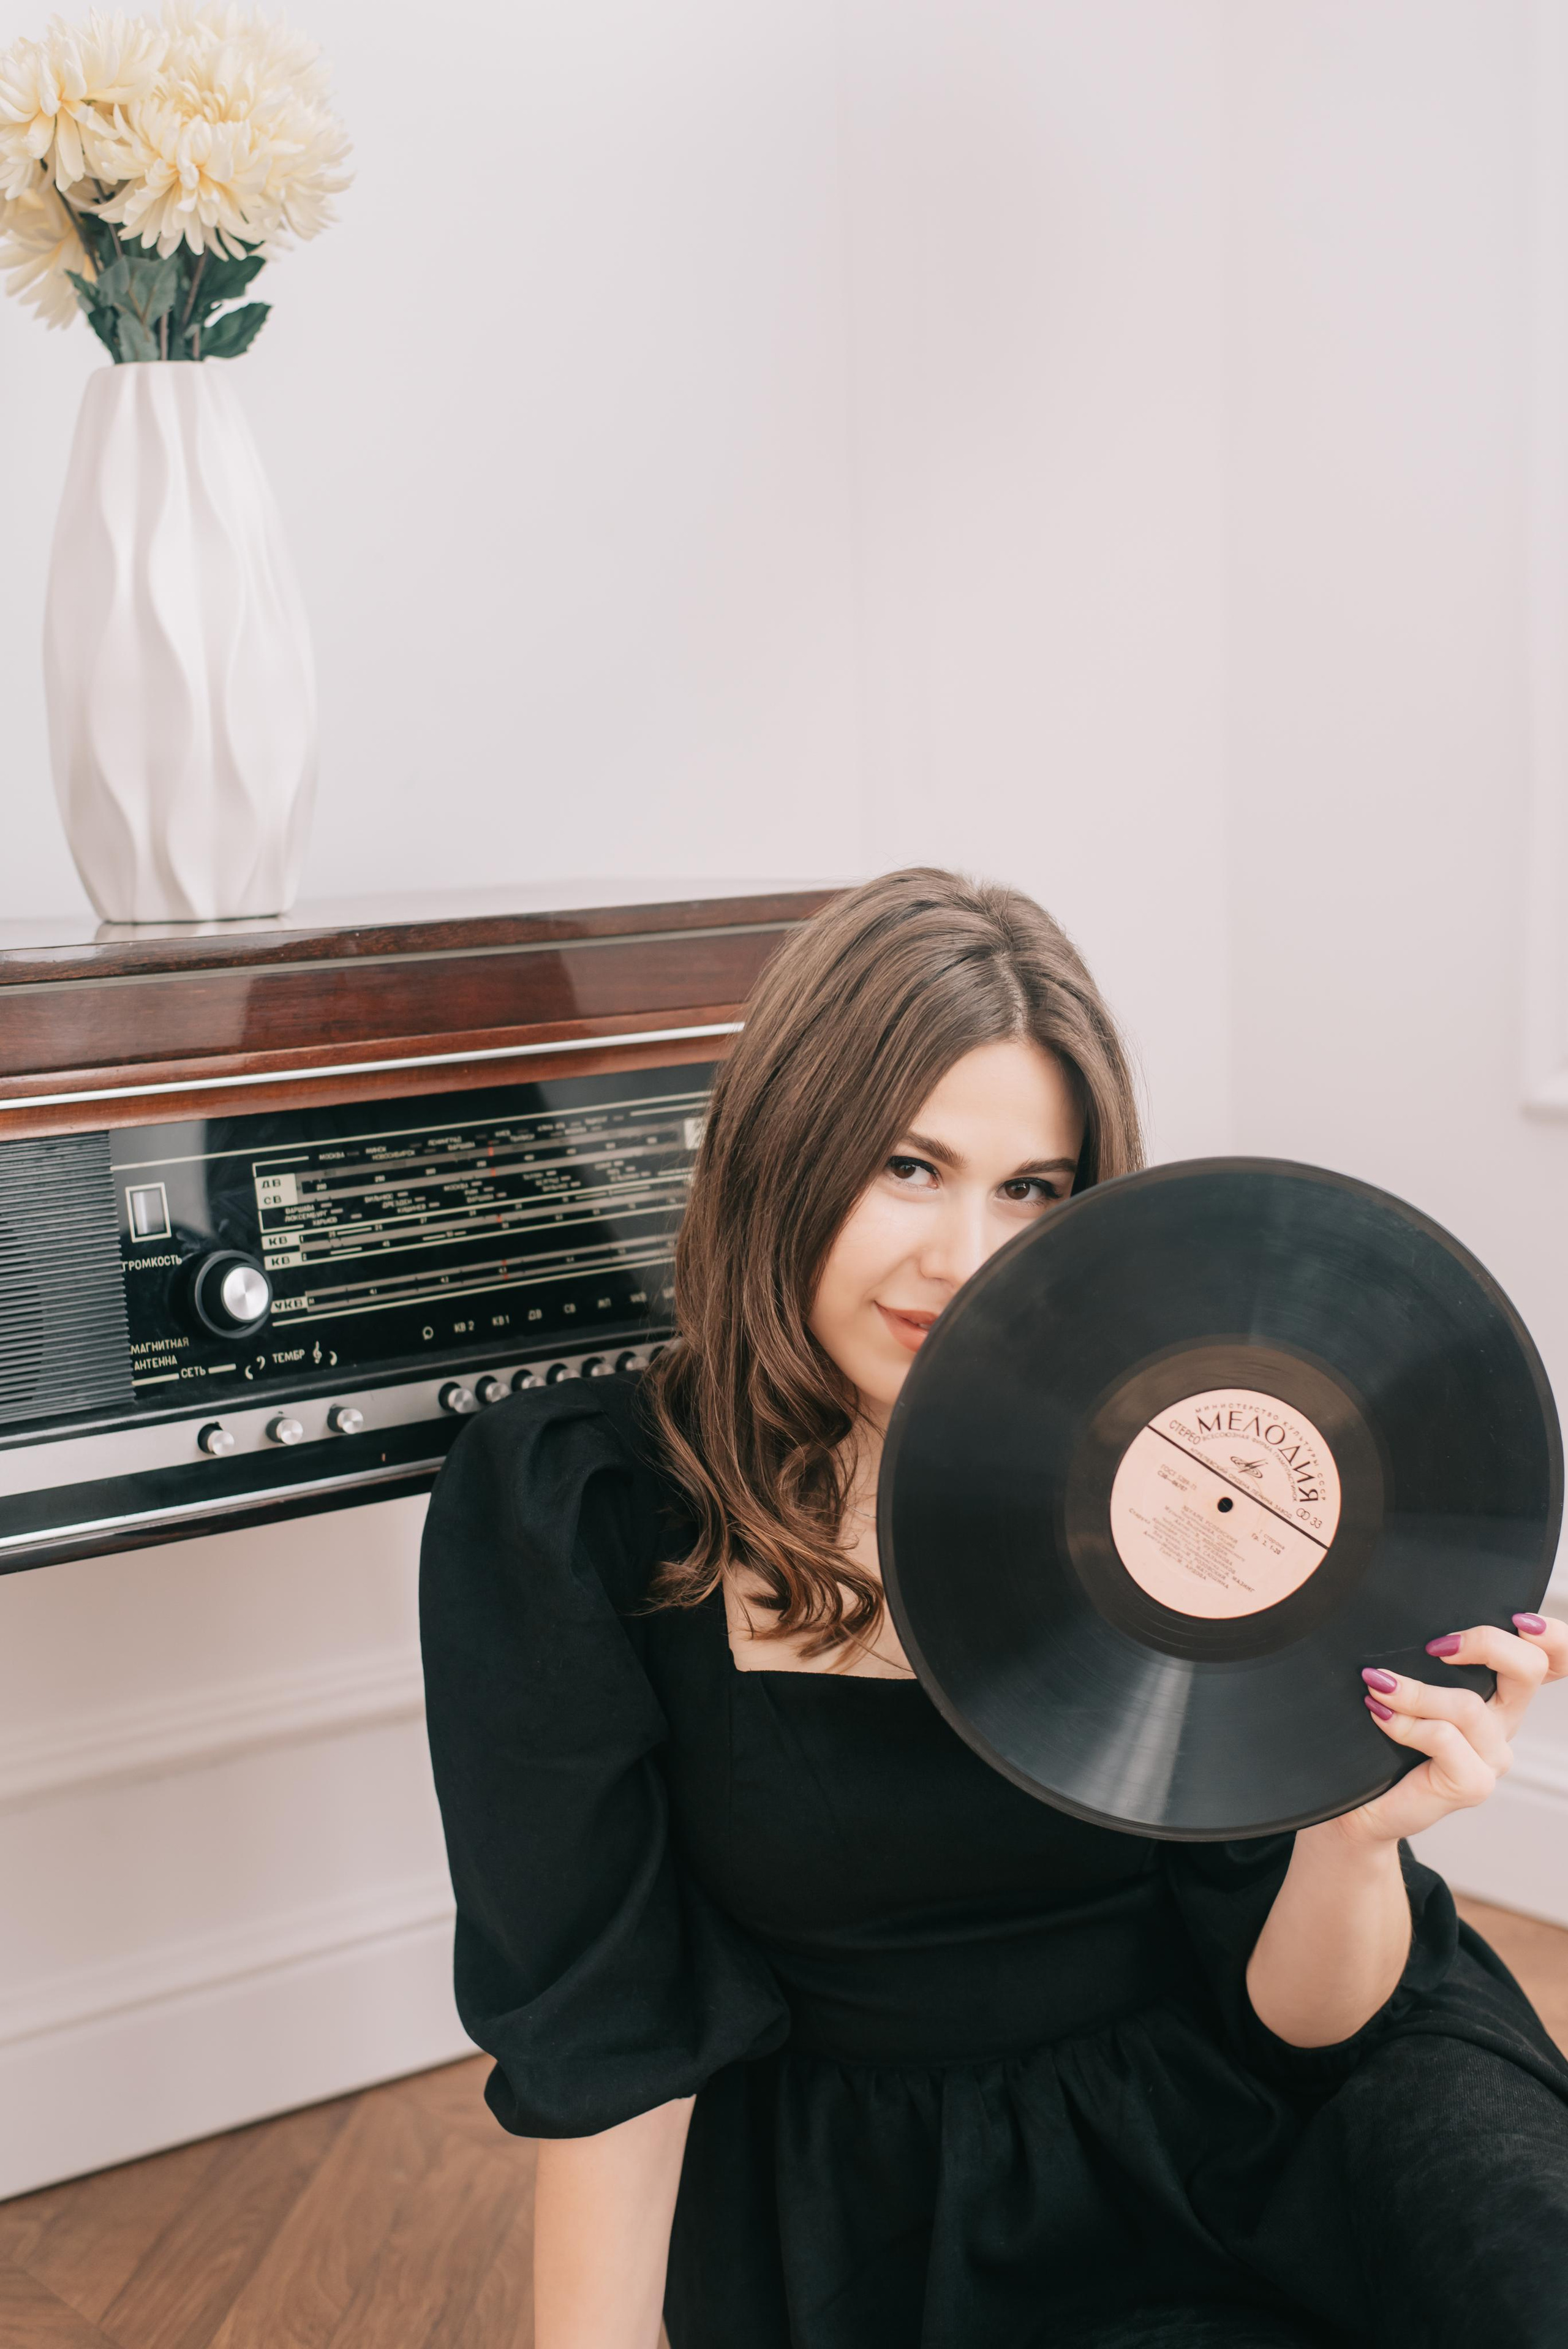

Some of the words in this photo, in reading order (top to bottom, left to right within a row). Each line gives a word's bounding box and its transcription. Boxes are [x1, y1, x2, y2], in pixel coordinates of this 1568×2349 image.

[319, 1151, 345, 1160] МОСКВА
[262, 1178, 281, 1189] ДВ
[263, 1195, 282, 1205] СВ
[284, 1209, 328, 1222] ЛЮКСЕМБУРГ
[285, 1205, 315, 1215] ВАРШАВА
[312, 1216, 337, 1226] ХАРЬКОВ
[269, 1236, 287, 1246] КВ
[122, 1254, 183, 1271] ГРОМКОСТЬ
[271, 1255, 290, 1266] КВ
[274, 1299, 303, 1311] УКВ
[454, 1322, 466, 1333] КВ
[468, 1320, 474, 1331] 2
[492, 1315, 505, 1326] КВ
[130, 1336, 189, 1355] МАГНИТНАЯ
[134, 1354, 178, 1371] АНТЕННА
[272, 1348, 305, 1364] ТЕМБР
[181, 1364, 206, 1380] СЕТЬ
[1169, 1420, 1201, 1445] СТЕРЕО
[1202, 1432, 1250, 1442] ВСЕСОЮЗНАЯ
[1195, 1402, 1280, 1421] МИНИСТЕРСТВО
[1283, 1421, 1320, 1467] КУЛЬТУРЫ
[1317, 1472, 1327, 1501] СССР
[1197, 1410, 1319, 1503] МЕЛОДИЯ
[1310, 1516, 1323, 1529] 33
